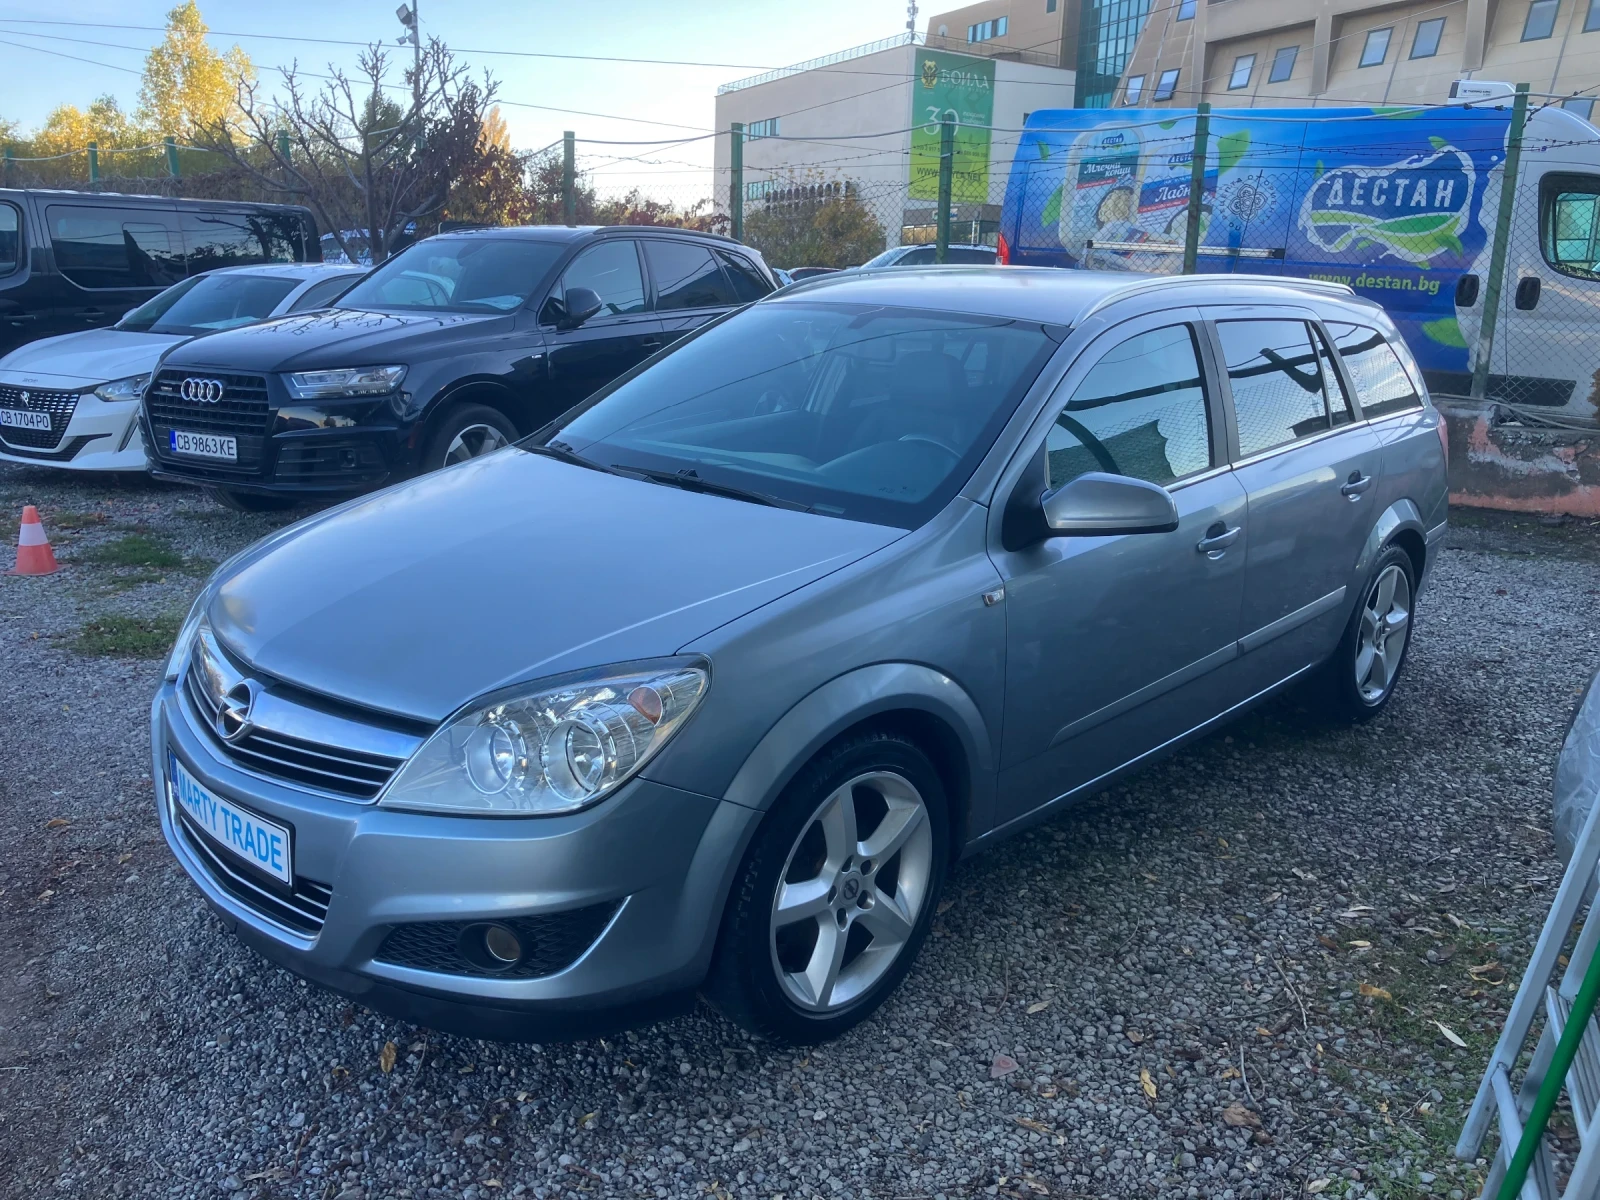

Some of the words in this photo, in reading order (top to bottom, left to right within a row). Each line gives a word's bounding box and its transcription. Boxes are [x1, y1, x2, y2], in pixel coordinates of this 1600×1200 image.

[1154, 183, 1192, 203] Лабн
[1326, 177, 1454, 208] ДЕСТАН
[1308, 272, 1441, 296] www.destan.bg
[179, 769, 217, 831] MARTY
[221, 807, 282, 872] TRADE
